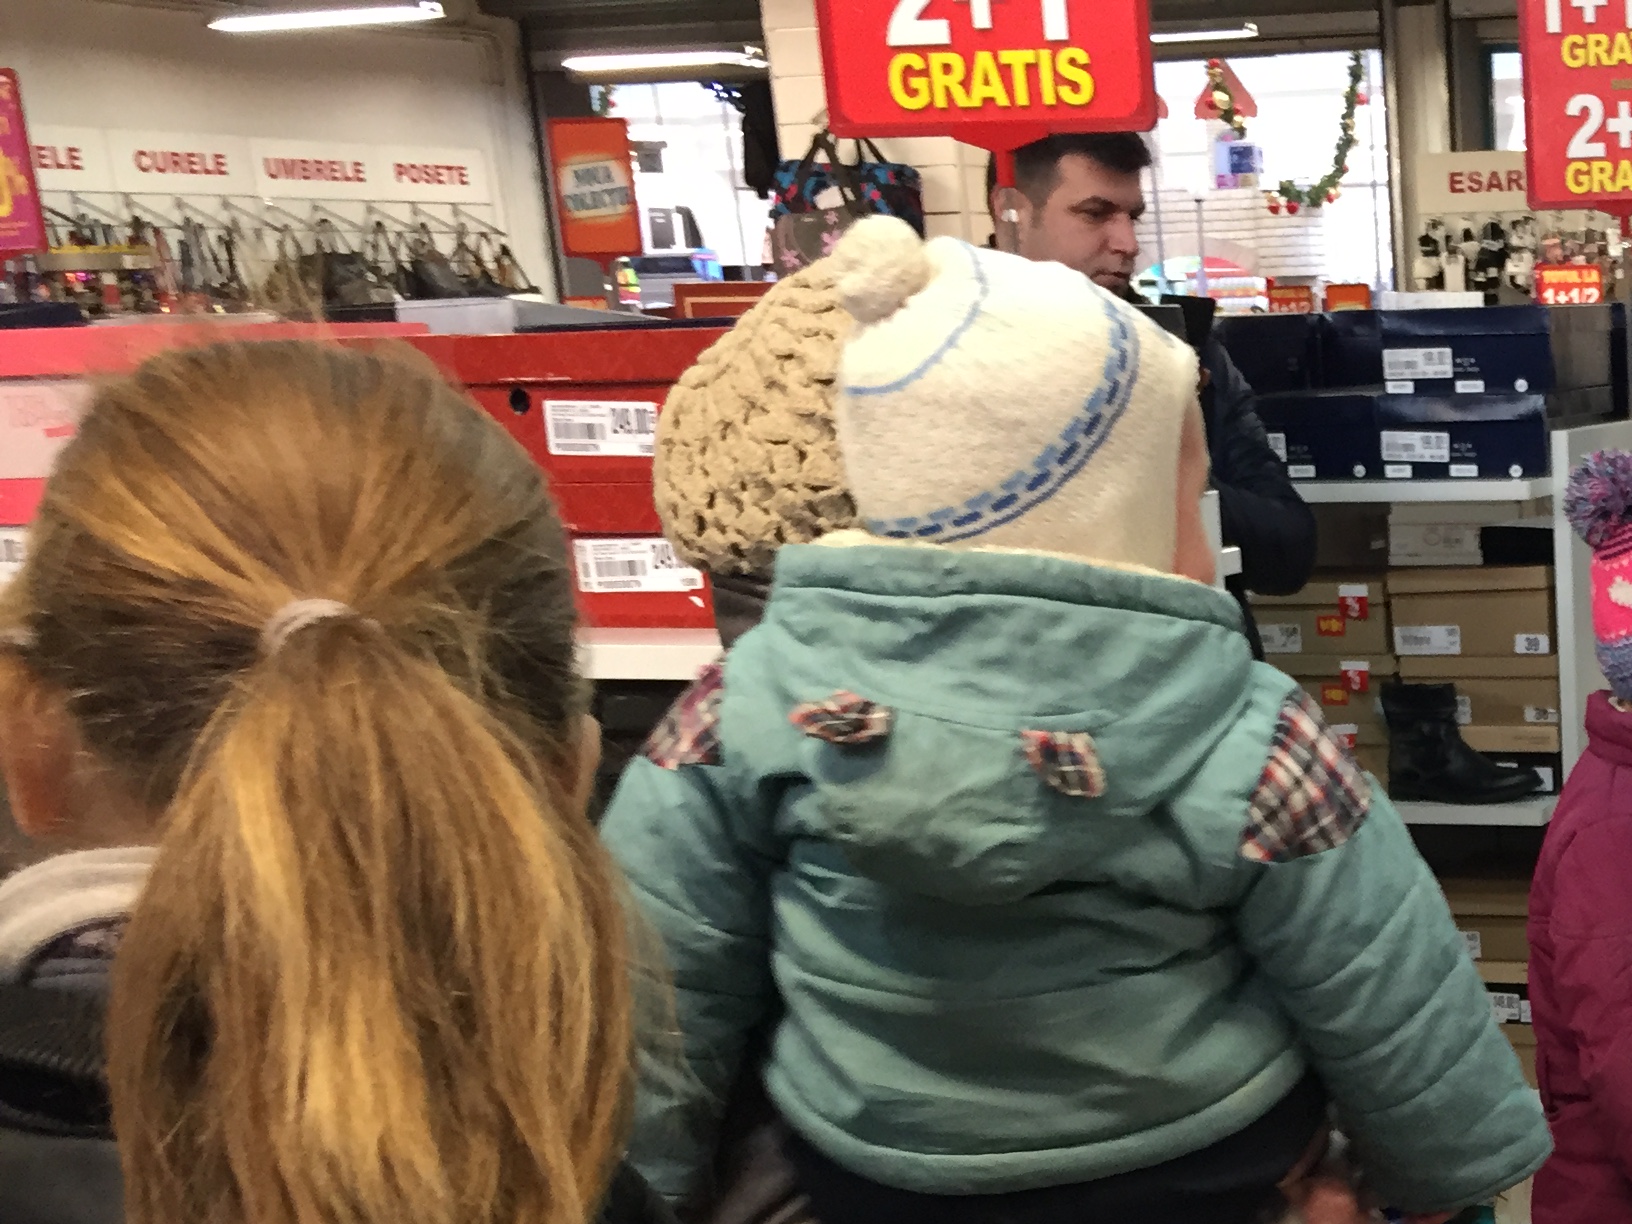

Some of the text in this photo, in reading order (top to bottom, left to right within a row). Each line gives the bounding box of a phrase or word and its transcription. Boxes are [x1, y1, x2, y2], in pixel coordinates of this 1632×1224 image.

[888, 47, 1095, 110] GRATIS
[134, 150, 229, 176] CURELE
[262, 156, 367, 183] UMBRELE
[393, 162, 471, 186] POSETE
